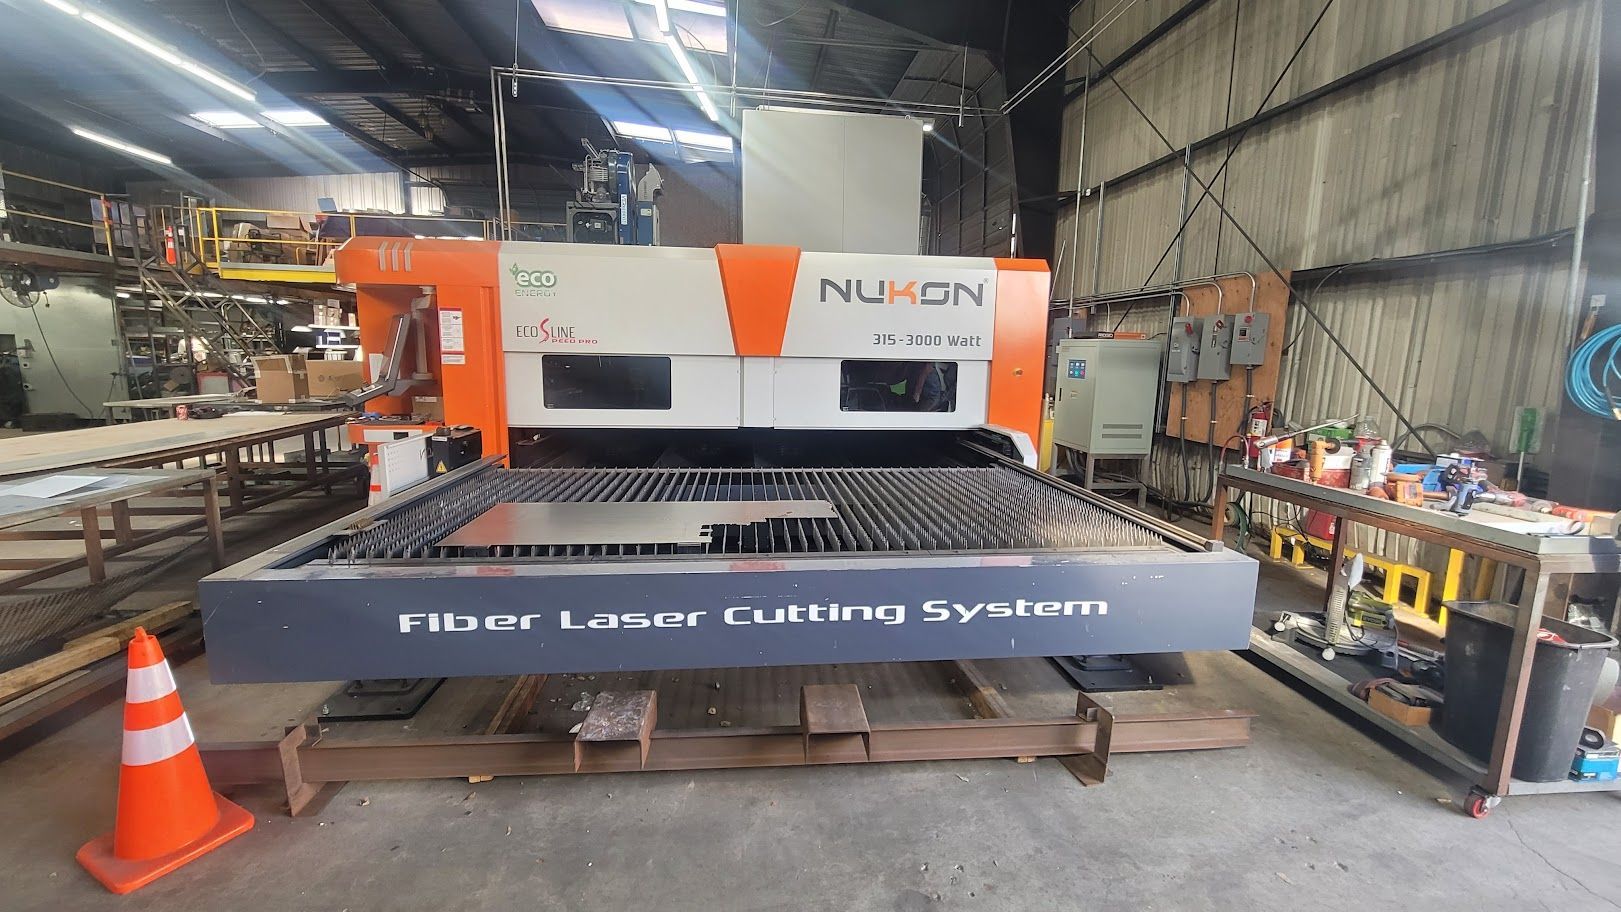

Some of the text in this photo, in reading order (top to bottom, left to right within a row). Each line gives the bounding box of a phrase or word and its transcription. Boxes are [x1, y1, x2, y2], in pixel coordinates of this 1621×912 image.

[515, 270, 557, 288] eco
[872, 333, 982, 347] 315-3000 Watt
[398, 599, 1109, 633] Fiber Laser Cutting System
